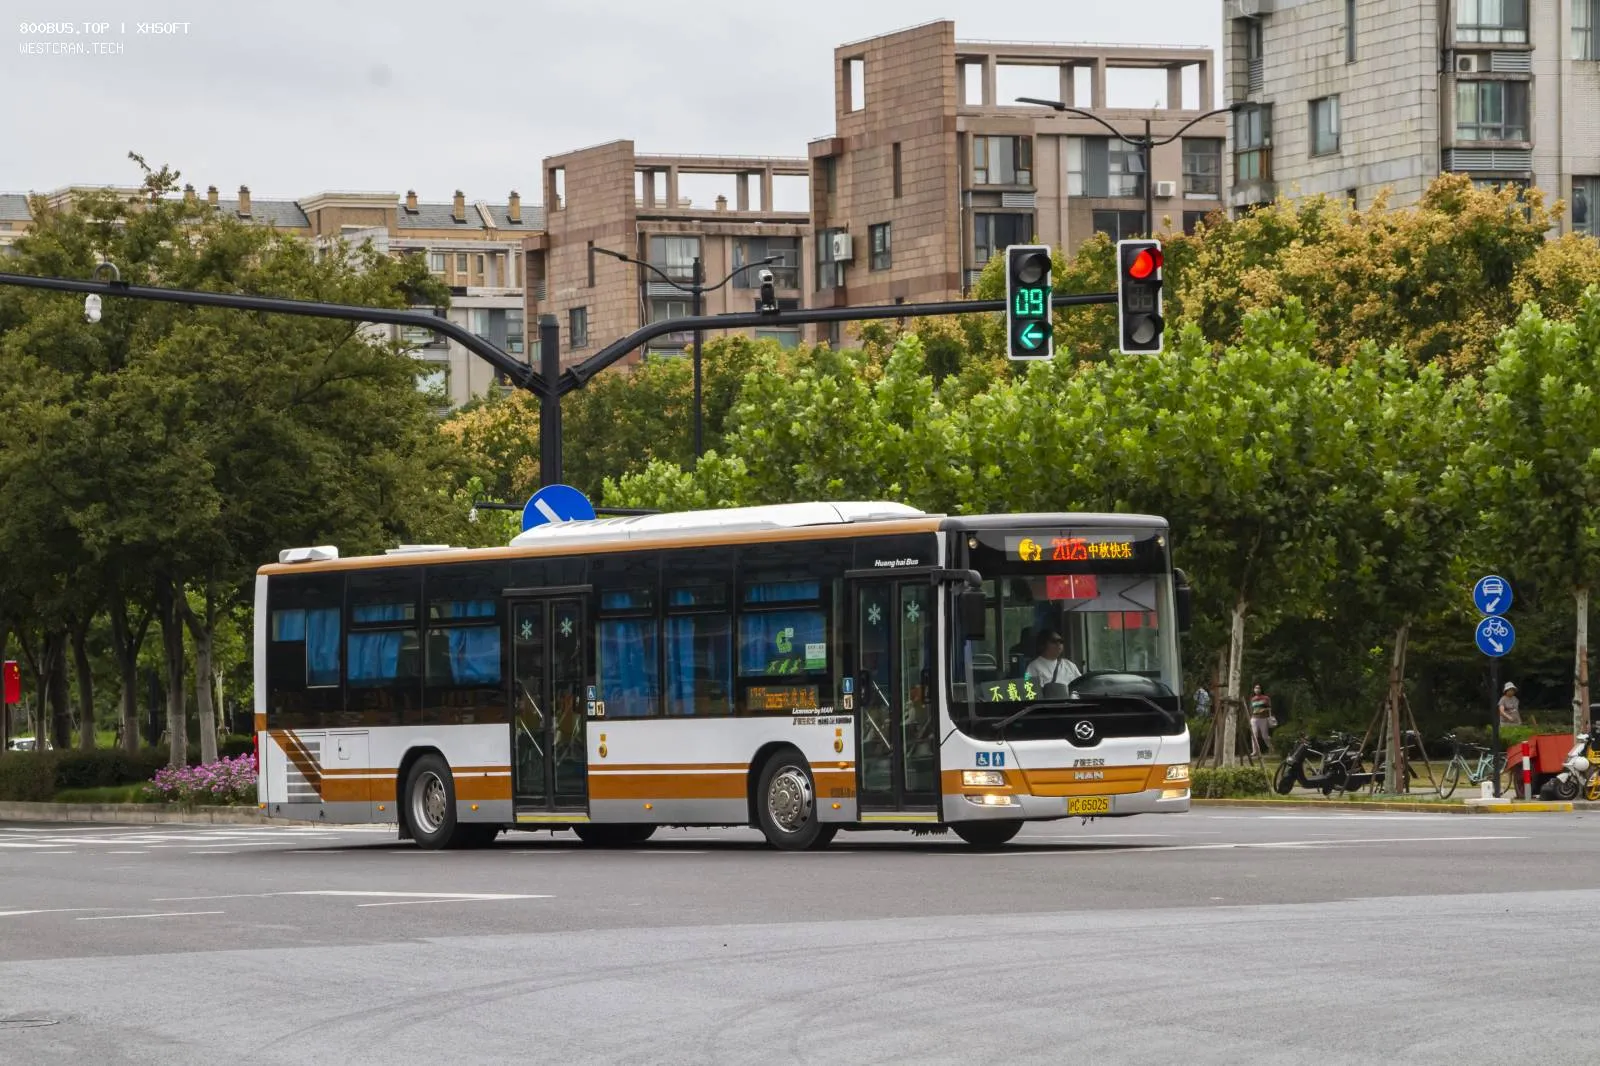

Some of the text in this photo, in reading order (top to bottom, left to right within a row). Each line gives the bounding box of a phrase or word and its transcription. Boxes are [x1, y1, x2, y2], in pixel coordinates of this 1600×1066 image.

[1016, 288, 1043, 315] 09
[1088, 542, 1132, 558] 中秋快乐
[1074, 771, 1104, 780] MAN
